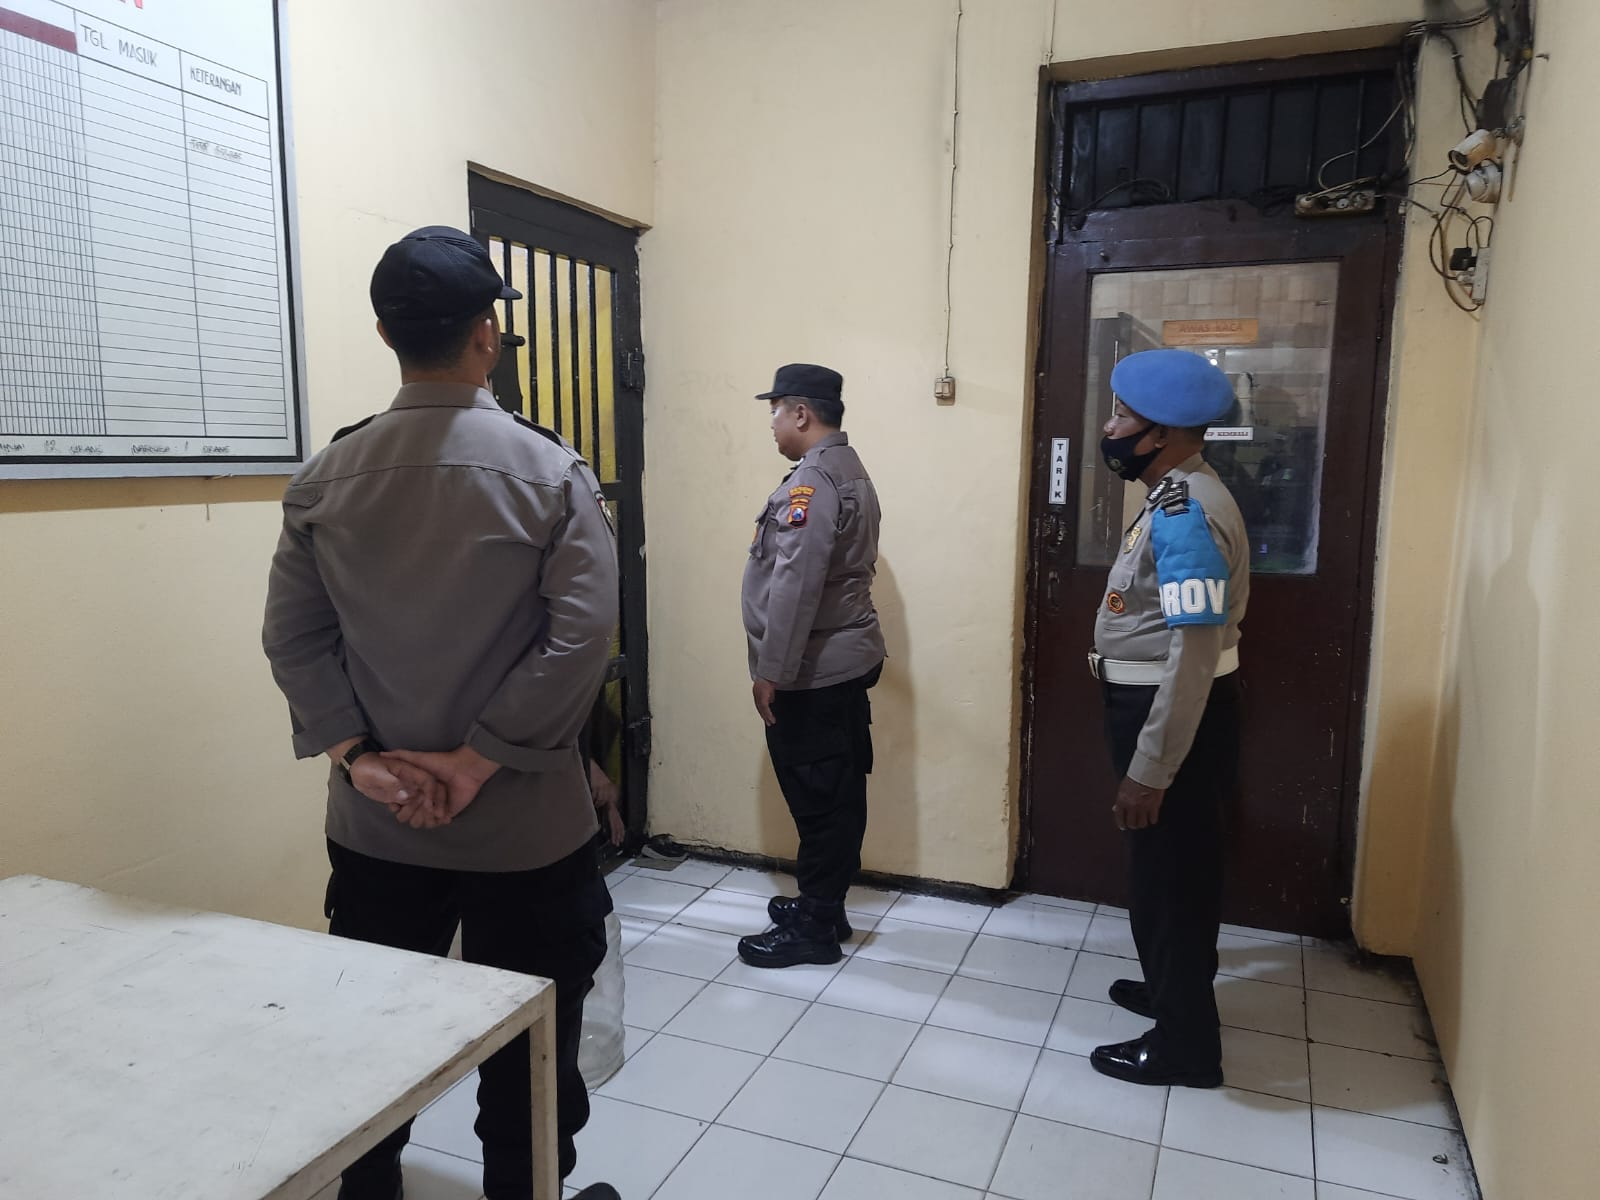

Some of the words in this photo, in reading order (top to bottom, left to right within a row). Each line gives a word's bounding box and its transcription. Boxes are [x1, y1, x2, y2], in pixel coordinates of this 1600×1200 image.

[80, 24, 108, 50] TGL
[118, 39, 158, 67] MASUK
[190, 66, 242, 96] KETERANGAN
[1054, 443, 1065, 498] TARIK
[1158, 578, 1226, 617] ROV
